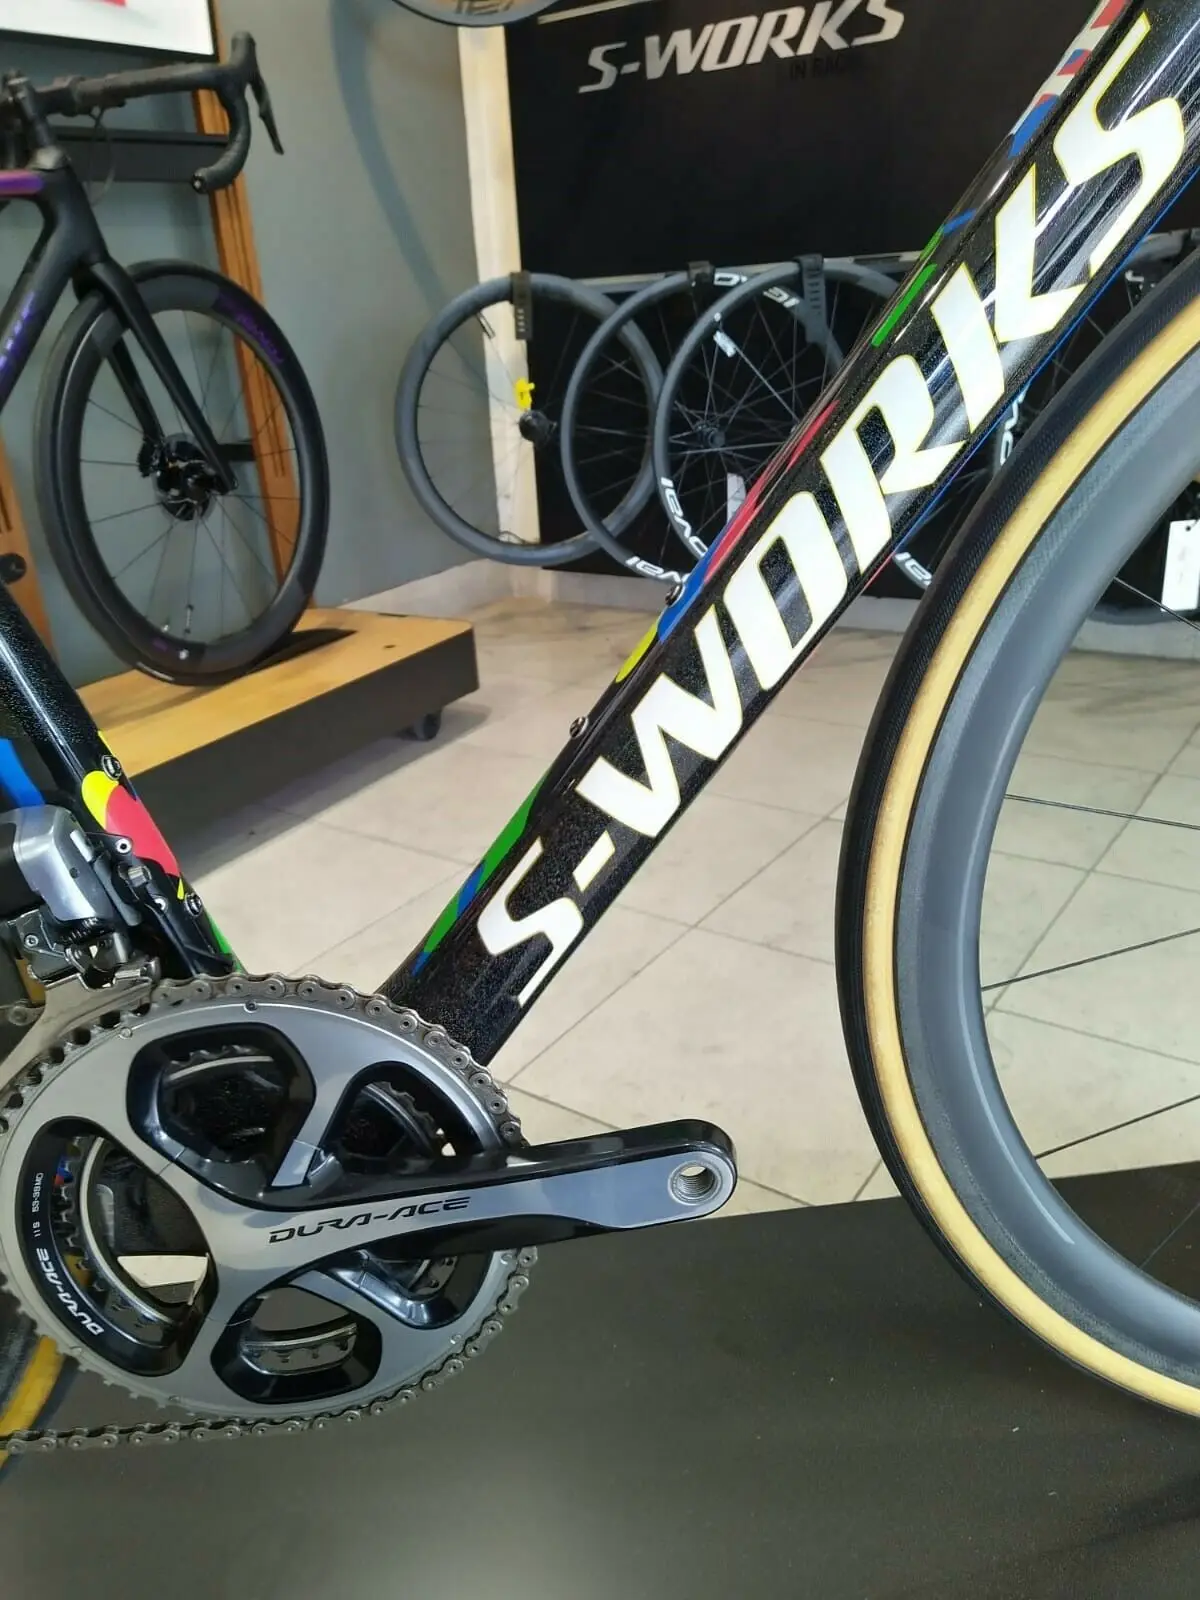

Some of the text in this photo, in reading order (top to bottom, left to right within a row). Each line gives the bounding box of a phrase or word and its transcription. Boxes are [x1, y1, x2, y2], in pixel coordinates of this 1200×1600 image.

[578, 0, 905, 93] S-WORKS
[477, 10, 1185, 1008] S-WORKS
[268, 1196, 471, 1244] DURA-ACE
[36, 1247, 105, 1336] DURA-ACE
